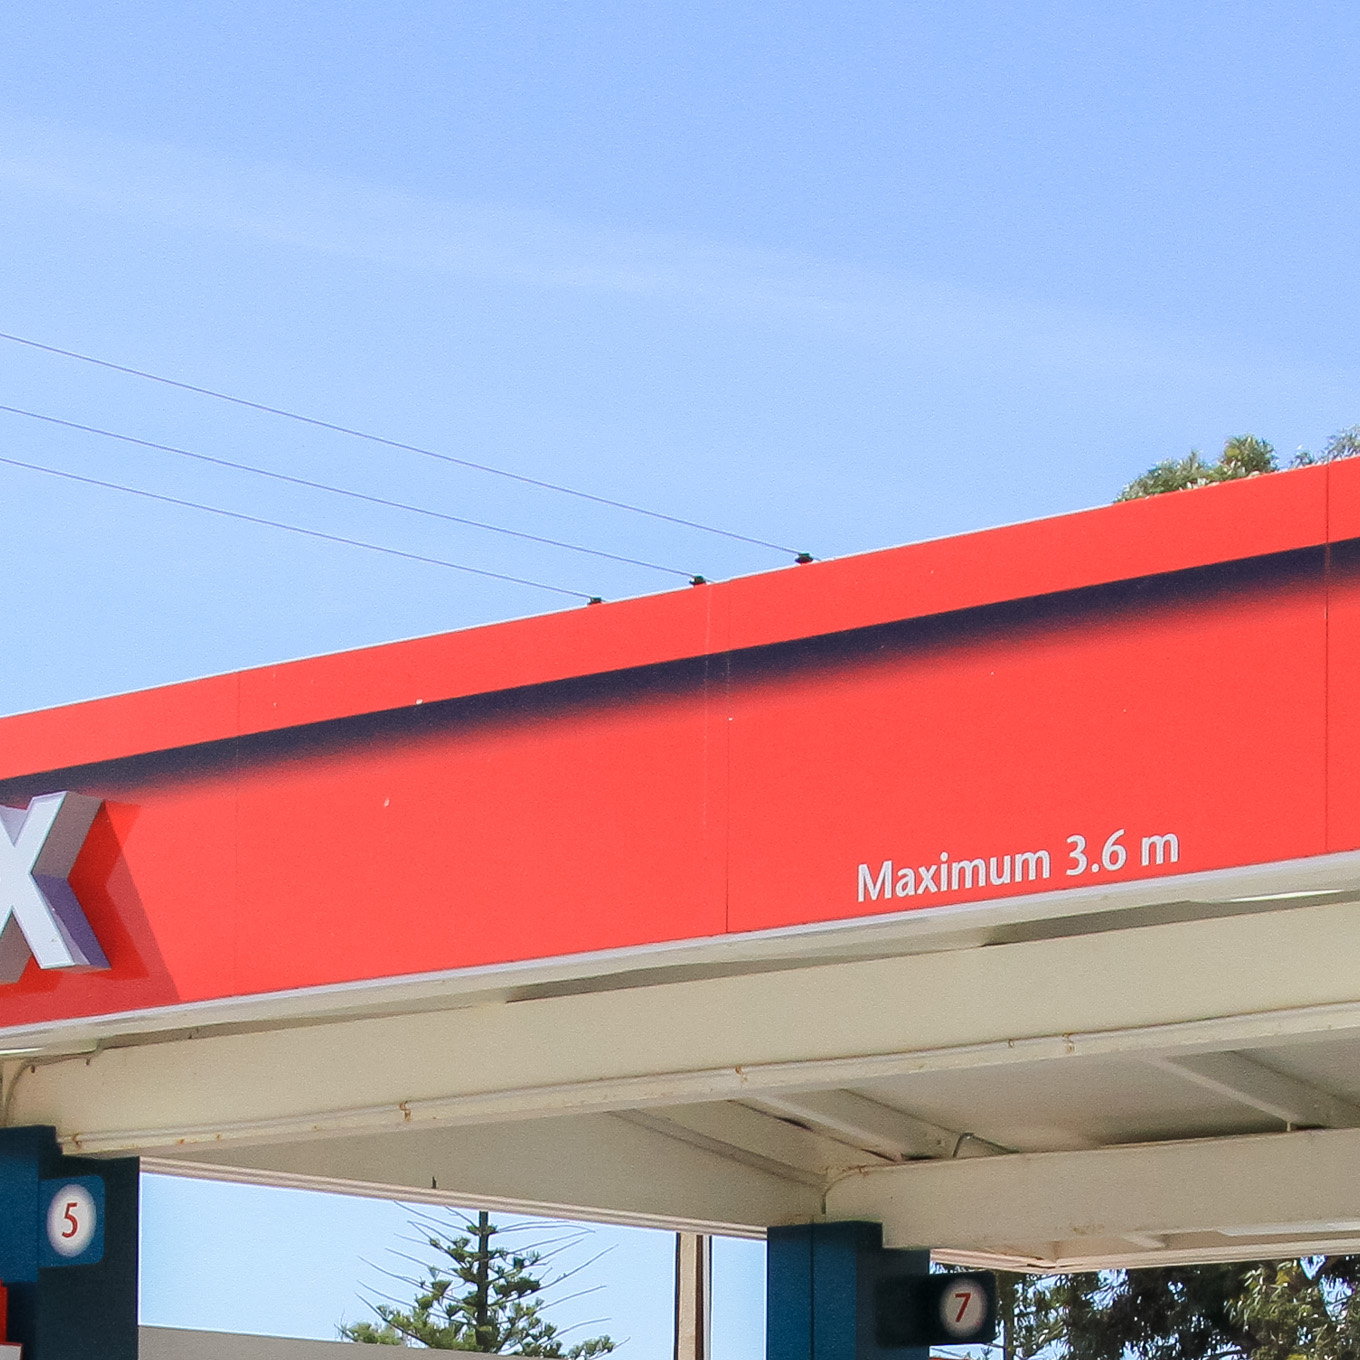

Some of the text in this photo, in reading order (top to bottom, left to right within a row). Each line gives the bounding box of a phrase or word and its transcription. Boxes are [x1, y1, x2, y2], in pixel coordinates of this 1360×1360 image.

[856, 828, 1180, 903] Maximum 3.6 m
[60, 1201, 79, 1239] 5
[954, 1291, 972, 1323] 7
